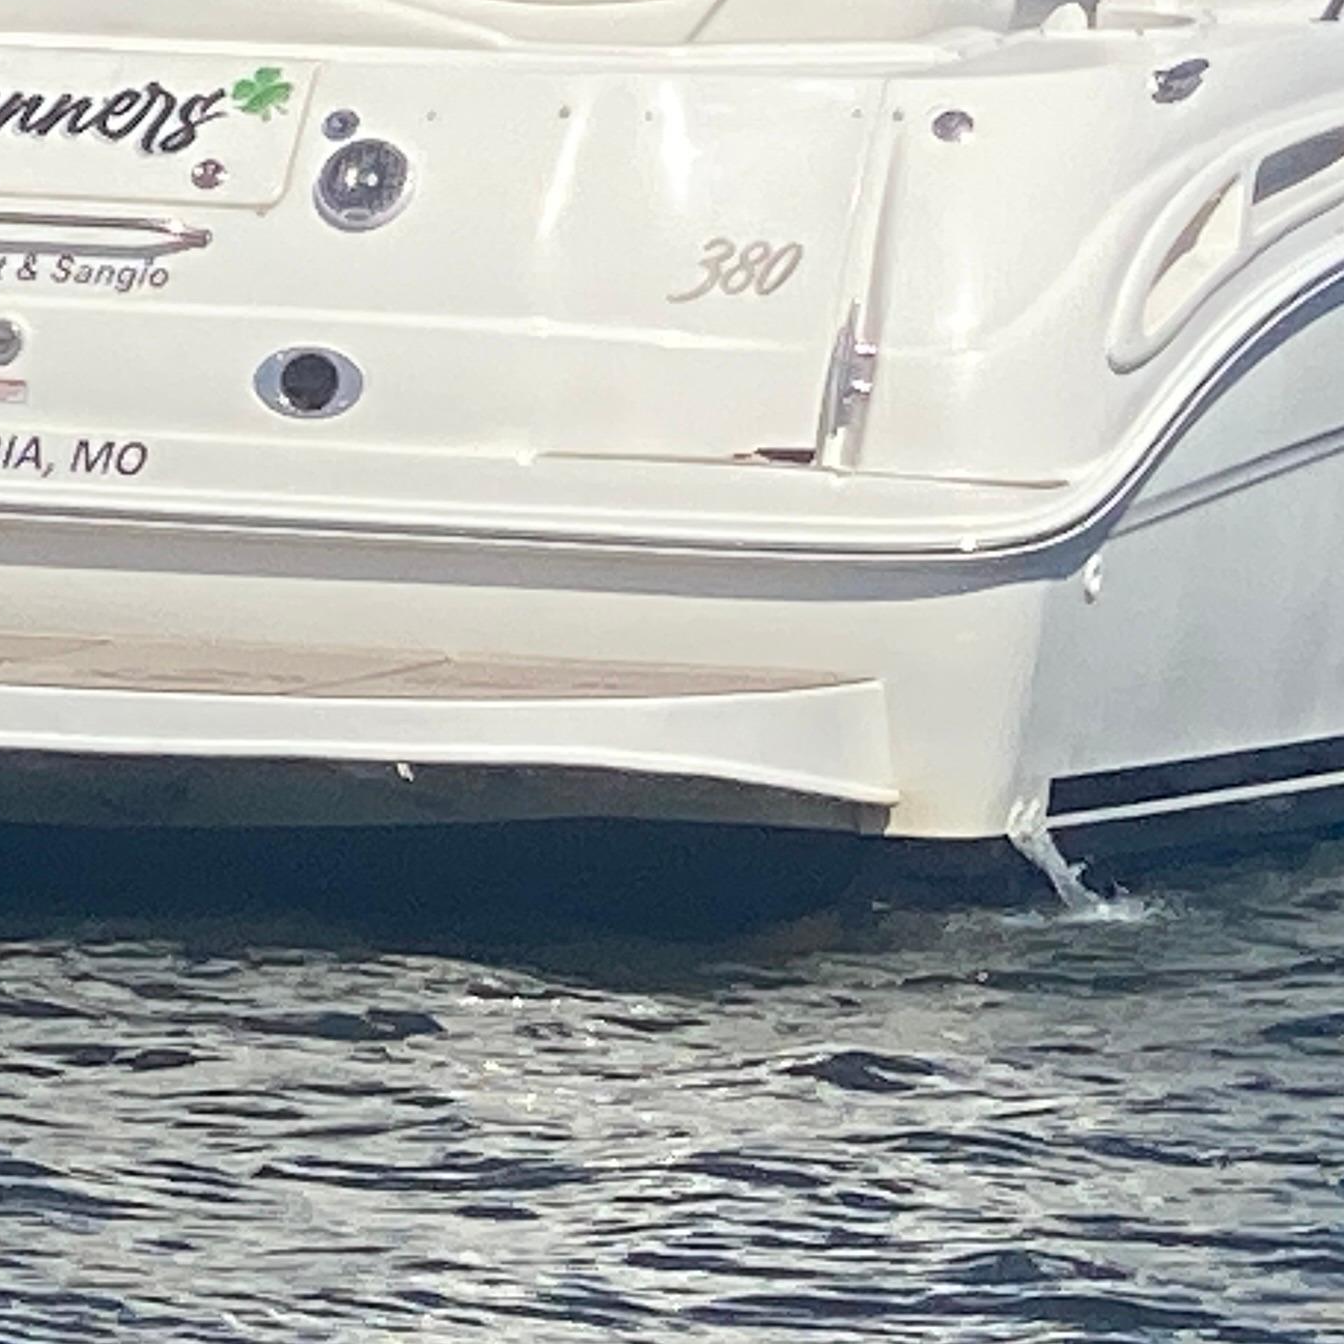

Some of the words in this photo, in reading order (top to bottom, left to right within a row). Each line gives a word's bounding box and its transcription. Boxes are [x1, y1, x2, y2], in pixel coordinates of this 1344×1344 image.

[17, 252, 38, 282] &
[51, 253, 170, 294] Sangio
[665, 237, 804, 304] 380
[69, 439, 149, 476] MO
